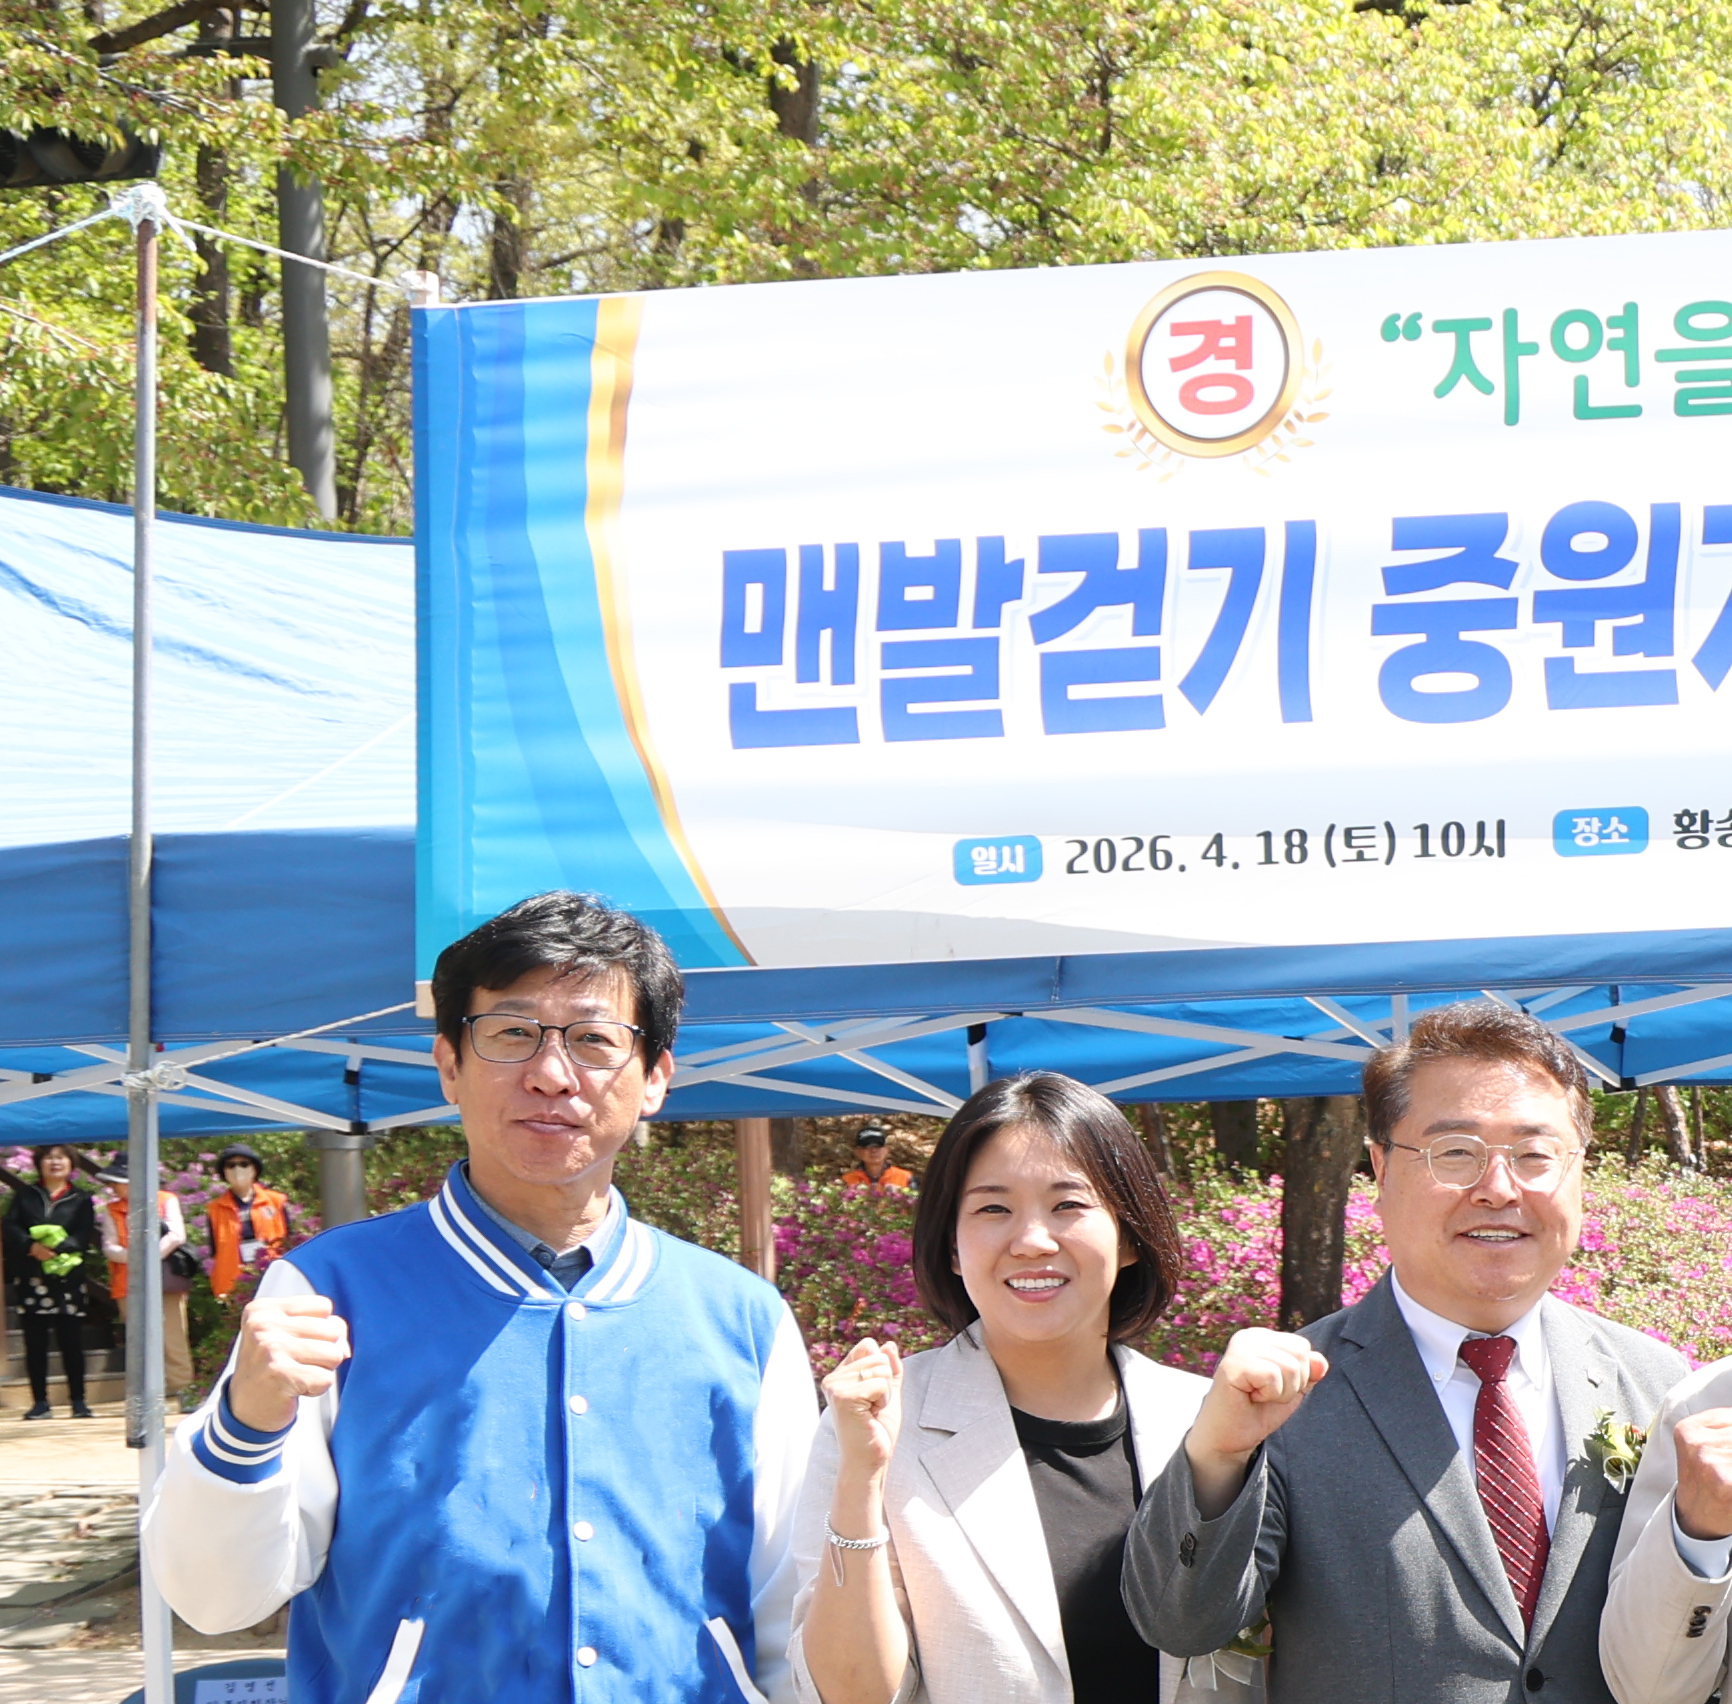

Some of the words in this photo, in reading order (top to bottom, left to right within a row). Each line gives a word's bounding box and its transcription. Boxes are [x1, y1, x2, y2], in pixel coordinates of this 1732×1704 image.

[1166, 315, 1257, 414] 경
[720, 519, 1318, 750] 맨발걷기
[970, 844, 1026, 876] 일시
[1066, 835, 1186, 875] 2026.
[1201, 832, 1240, 870] 4.
[1256, 828, 1308, 865] 18
[1324, 820, 1396, 868] (토)
[1413, 818, 1506, 858] 10시
[1571, 816, 1630, 848] 장소
